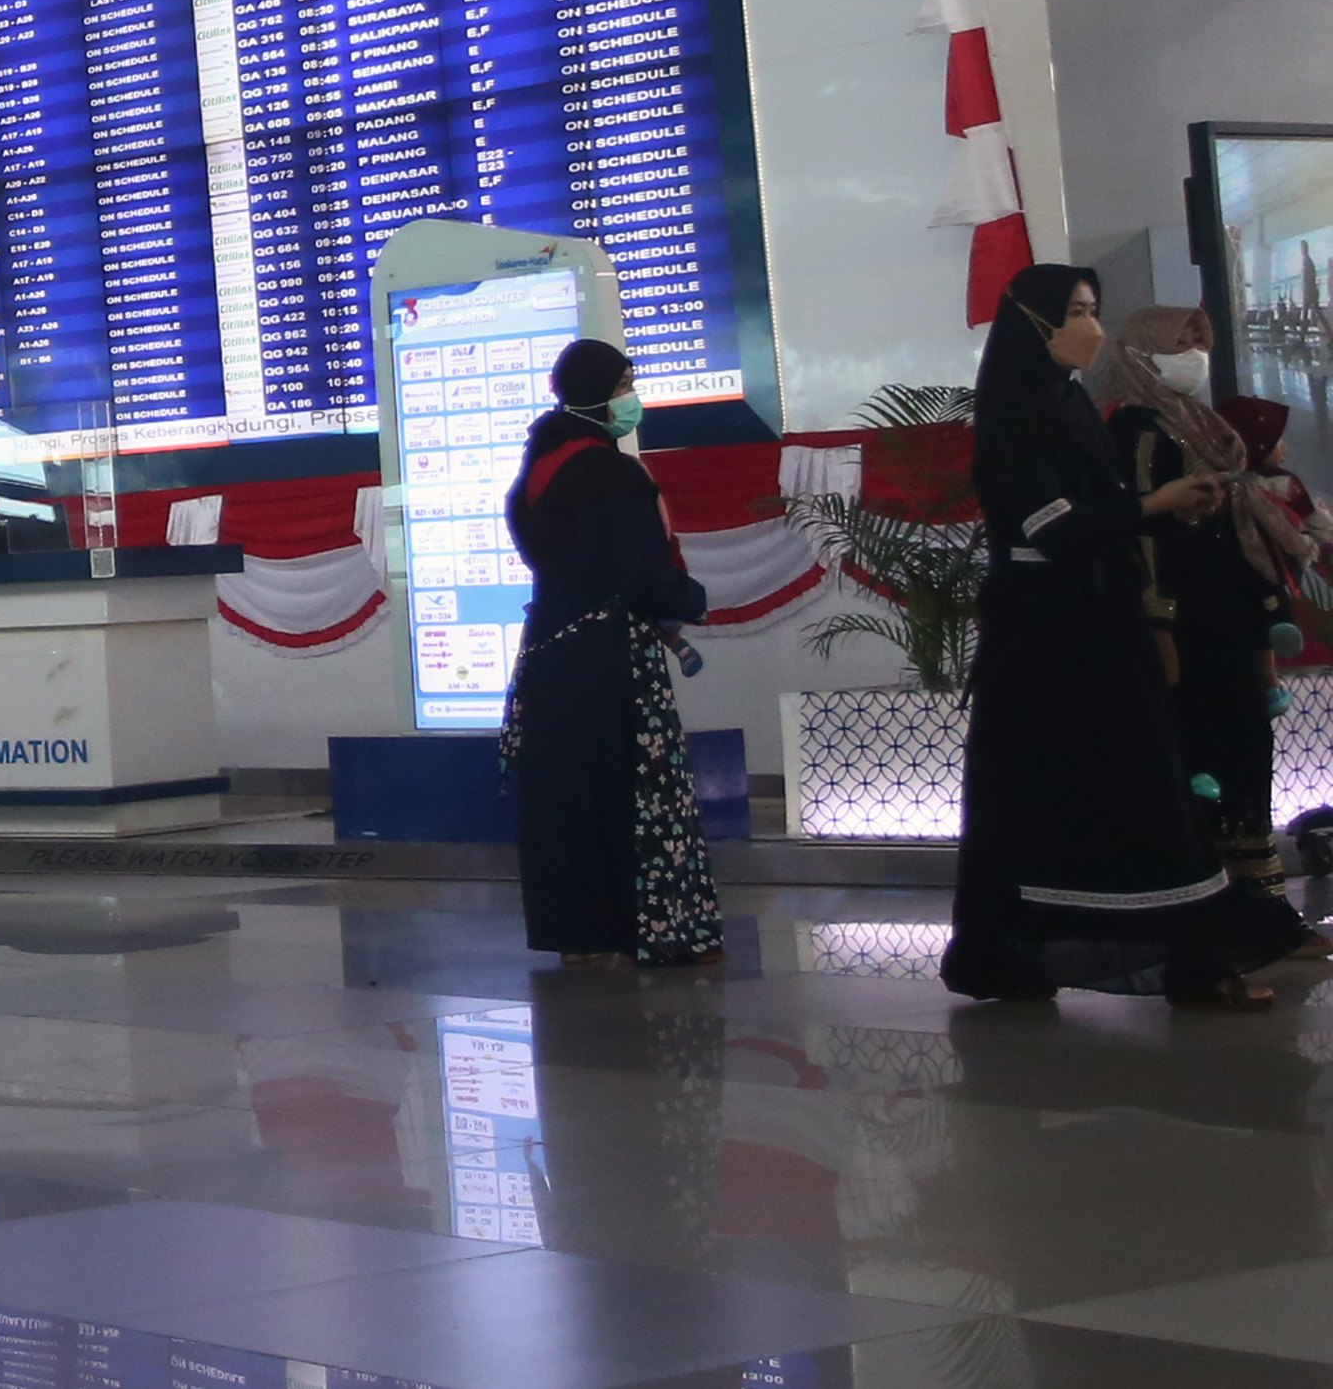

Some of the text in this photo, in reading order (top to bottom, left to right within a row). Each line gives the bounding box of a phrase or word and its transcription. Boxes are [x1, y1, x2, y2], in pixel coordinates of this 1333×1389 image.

[83, 2, 153, 25] ON SCHEDULE
[560, 45, 680, 75] ON SCHEDULE
[471, 79, 495, 92] E,F
[355, 90, 436, 114] MAKASSAR
[306, 107, 343, 122] 09:05
[244, 121, 265, 133] GA
[570, 165, 689, 191] ON SCHEDULE
[480, 195, 491, 205] E
[363, 198, 468, 224] LABUAN BAJO
[253, 224, 298, 239] QG 632
[314, 216, 351, 230] 09:35
[421, 290, 526, 311] CHECK IN COUNTER
[660, 300, 703, 314] 13:00
[423, 313, 498, 329] INFORMATION
[634, 373, 737, 396] emakin
[267, 398, 312, 411] GA 186
[328, 393, 365, 405] 10:50
[311, 408, 380, 427] Prose
[134, 420, 229, 440] Keberangk
[29, 848, 375, 869] PLEASE WATCH YOUR STEP
